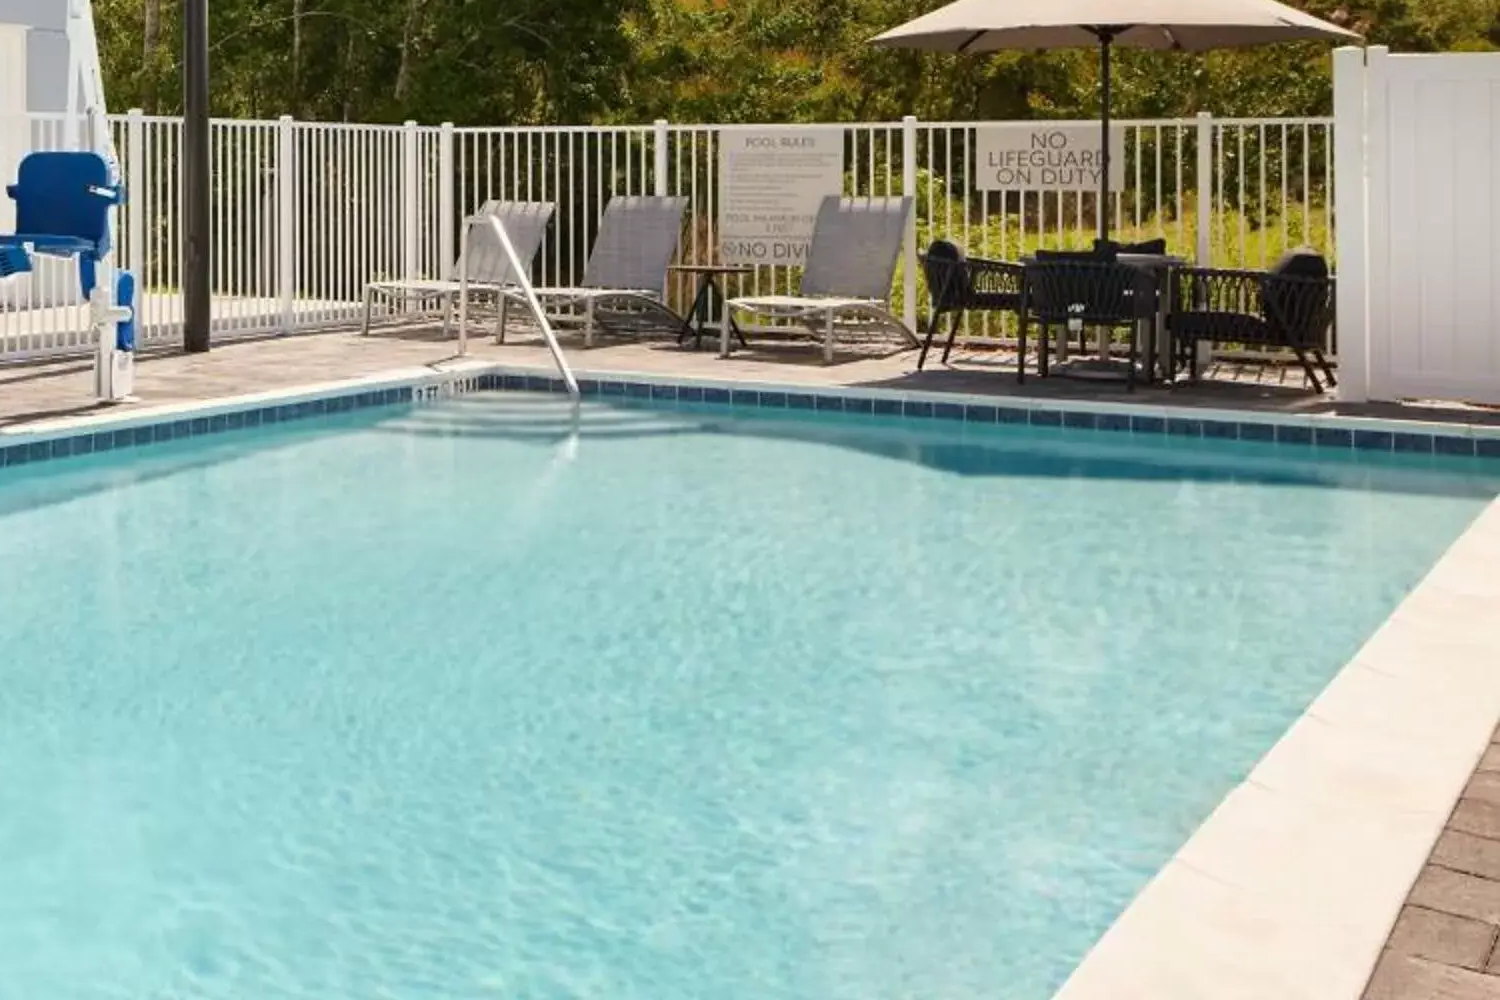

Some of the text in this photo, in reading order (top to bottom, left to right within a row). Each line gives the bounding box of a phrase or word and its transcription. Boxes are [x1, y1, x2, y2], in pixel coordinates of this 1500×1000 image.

[745, 137, 775, 148] POOL
[1031, 131, 1067, 149] NO
[996, 168, 1104, 185] ON DUTY
[738, 242, 810, 258] NO DIVI
